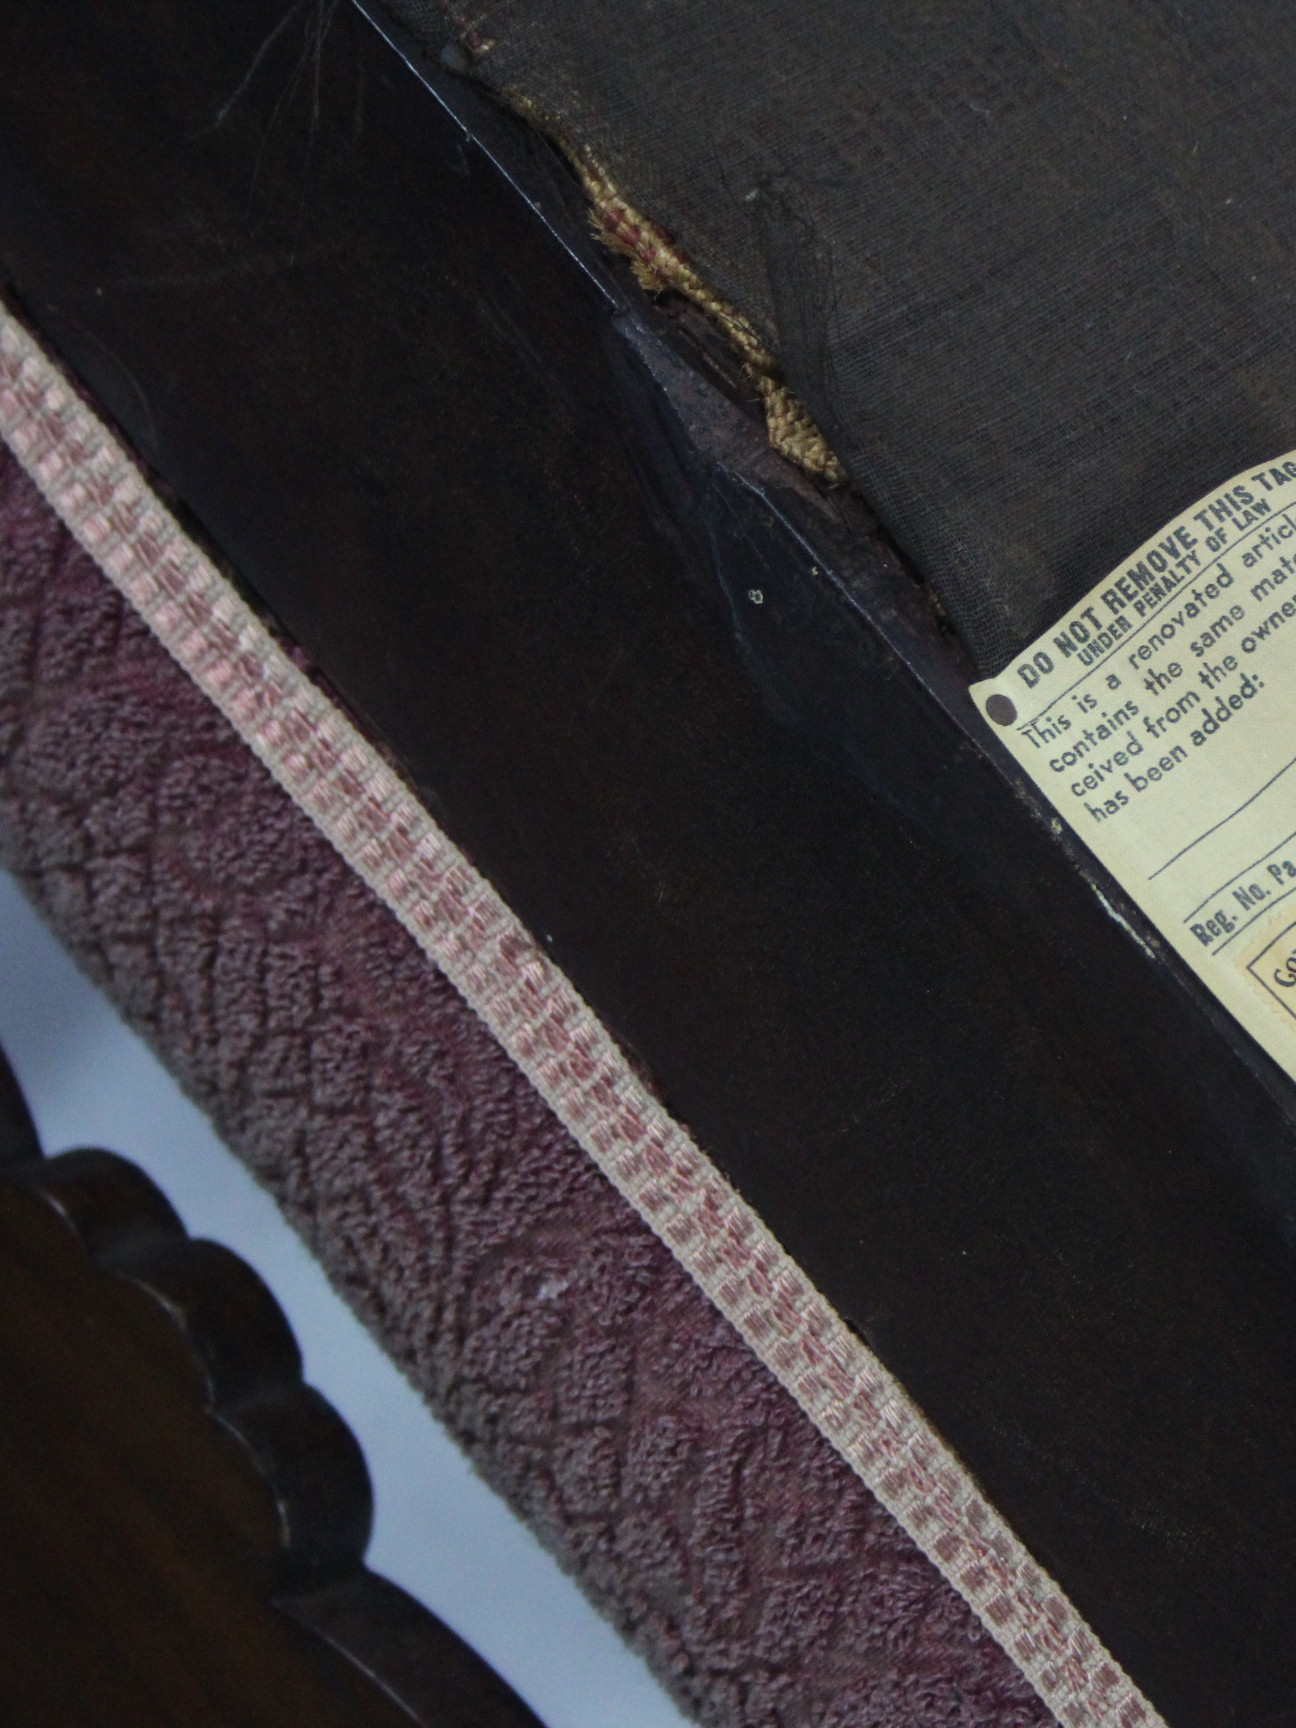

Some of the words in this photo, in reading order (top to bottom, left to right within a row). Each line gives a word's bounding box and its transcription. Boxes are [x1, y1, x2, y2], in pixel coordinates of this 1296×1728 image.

[1017, 651, 1054, 688] DO
[1054, 607, 1106, 657] NOT
[1101, 526, 1197, 614] REMOVE
[1194, 486, 1255, 535] THIS
[1020, 711, 1071, 750] This
[1073, 691, 1098, 716] is
[1105, 674, 1121, 690] a
[1129, 564, 1235, 670] renovated
[1077, 616, 1132, 667] UNDER
[1138, 552, 1199, 617] PENALTY
[1206, 529, 1229, 552] OF
[1233, 500, 1272, 532] LAW
[1049, 702, 1140, 774] contains
[1144, 659, 1183, 696] the
[1190, 603, 1245, 657] same
[1071, 732, 1144, 798] ceived
[1144, 690, 1200, 739] from
[1198, 654, 1238, 690] the
[1084, 789, 1129, 822] has
[1124, 746, 1188, 792] been
[1190, 674, 1265, 747] added:
[1190, 909, 1238, 947] Reg.
[1231, 883, 1272, 911] No.
